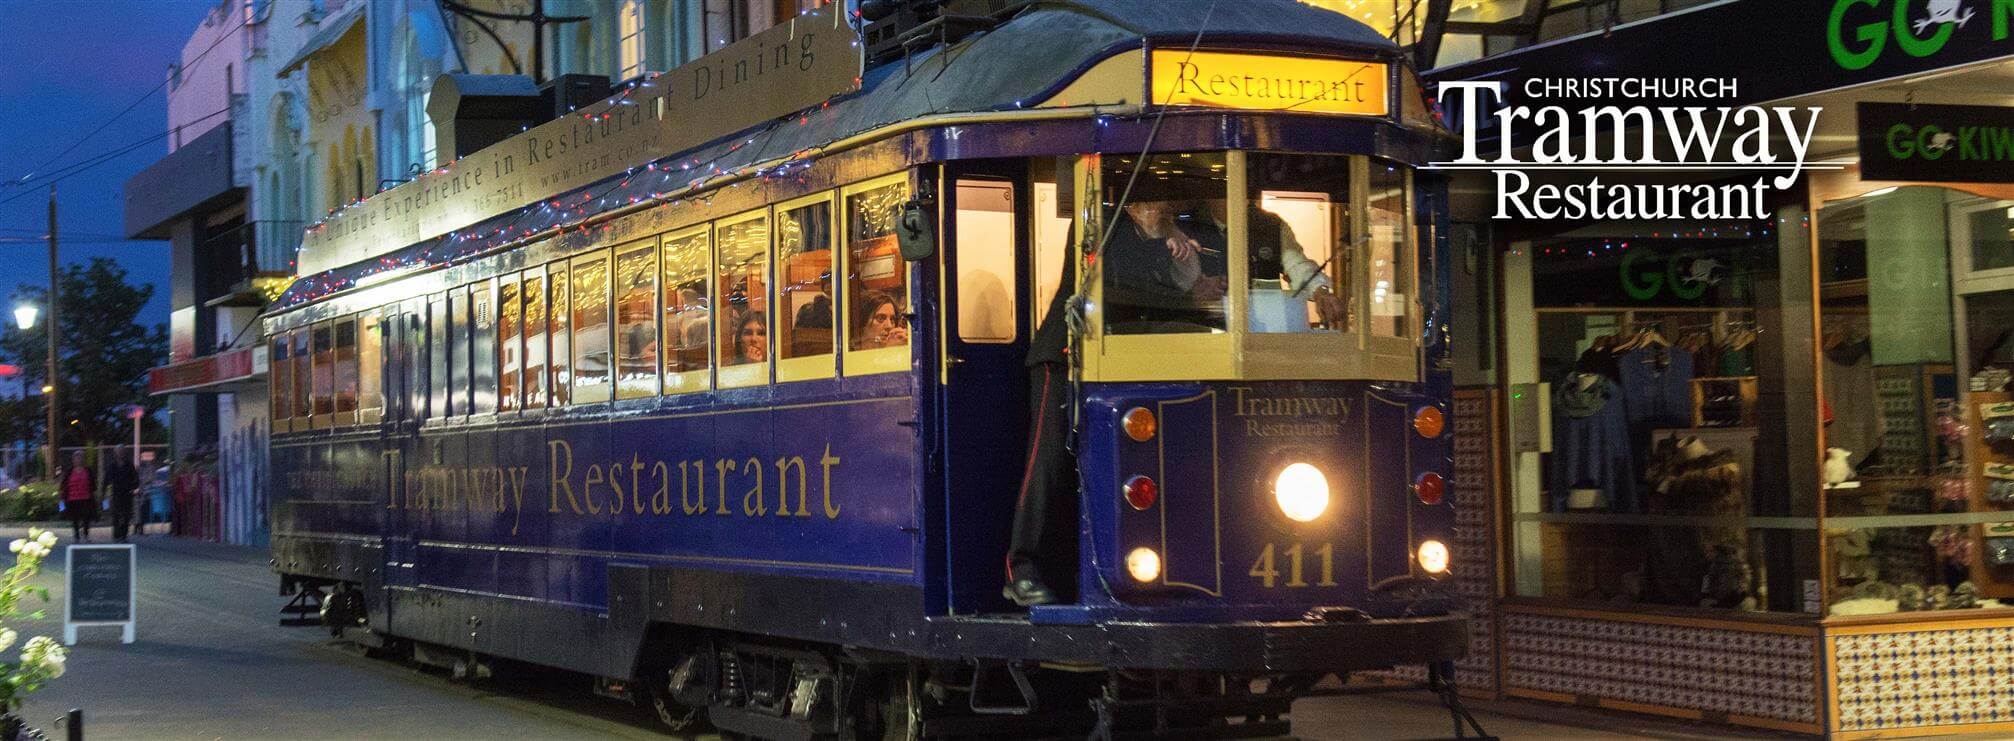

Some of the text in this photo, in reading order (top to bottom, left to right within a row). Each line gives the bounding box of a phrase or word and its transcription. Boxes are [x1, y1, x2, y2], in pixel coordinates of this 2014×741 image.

[1177, 61, 1365, 103] Restaurant
[384, 165, 482, 221] Experience
[495, 152, 514, 178] in
[528, 84, 674, 166] Restaurant
[694, 32, 815, 100] Dining
[1228, 387, 1353, 423] Tramway
[1246, 419, 1342, 437] Restaurant
[381, 439, 842, 536] Tramway Restaurant
[1249, 542, 1336, 588] 411
